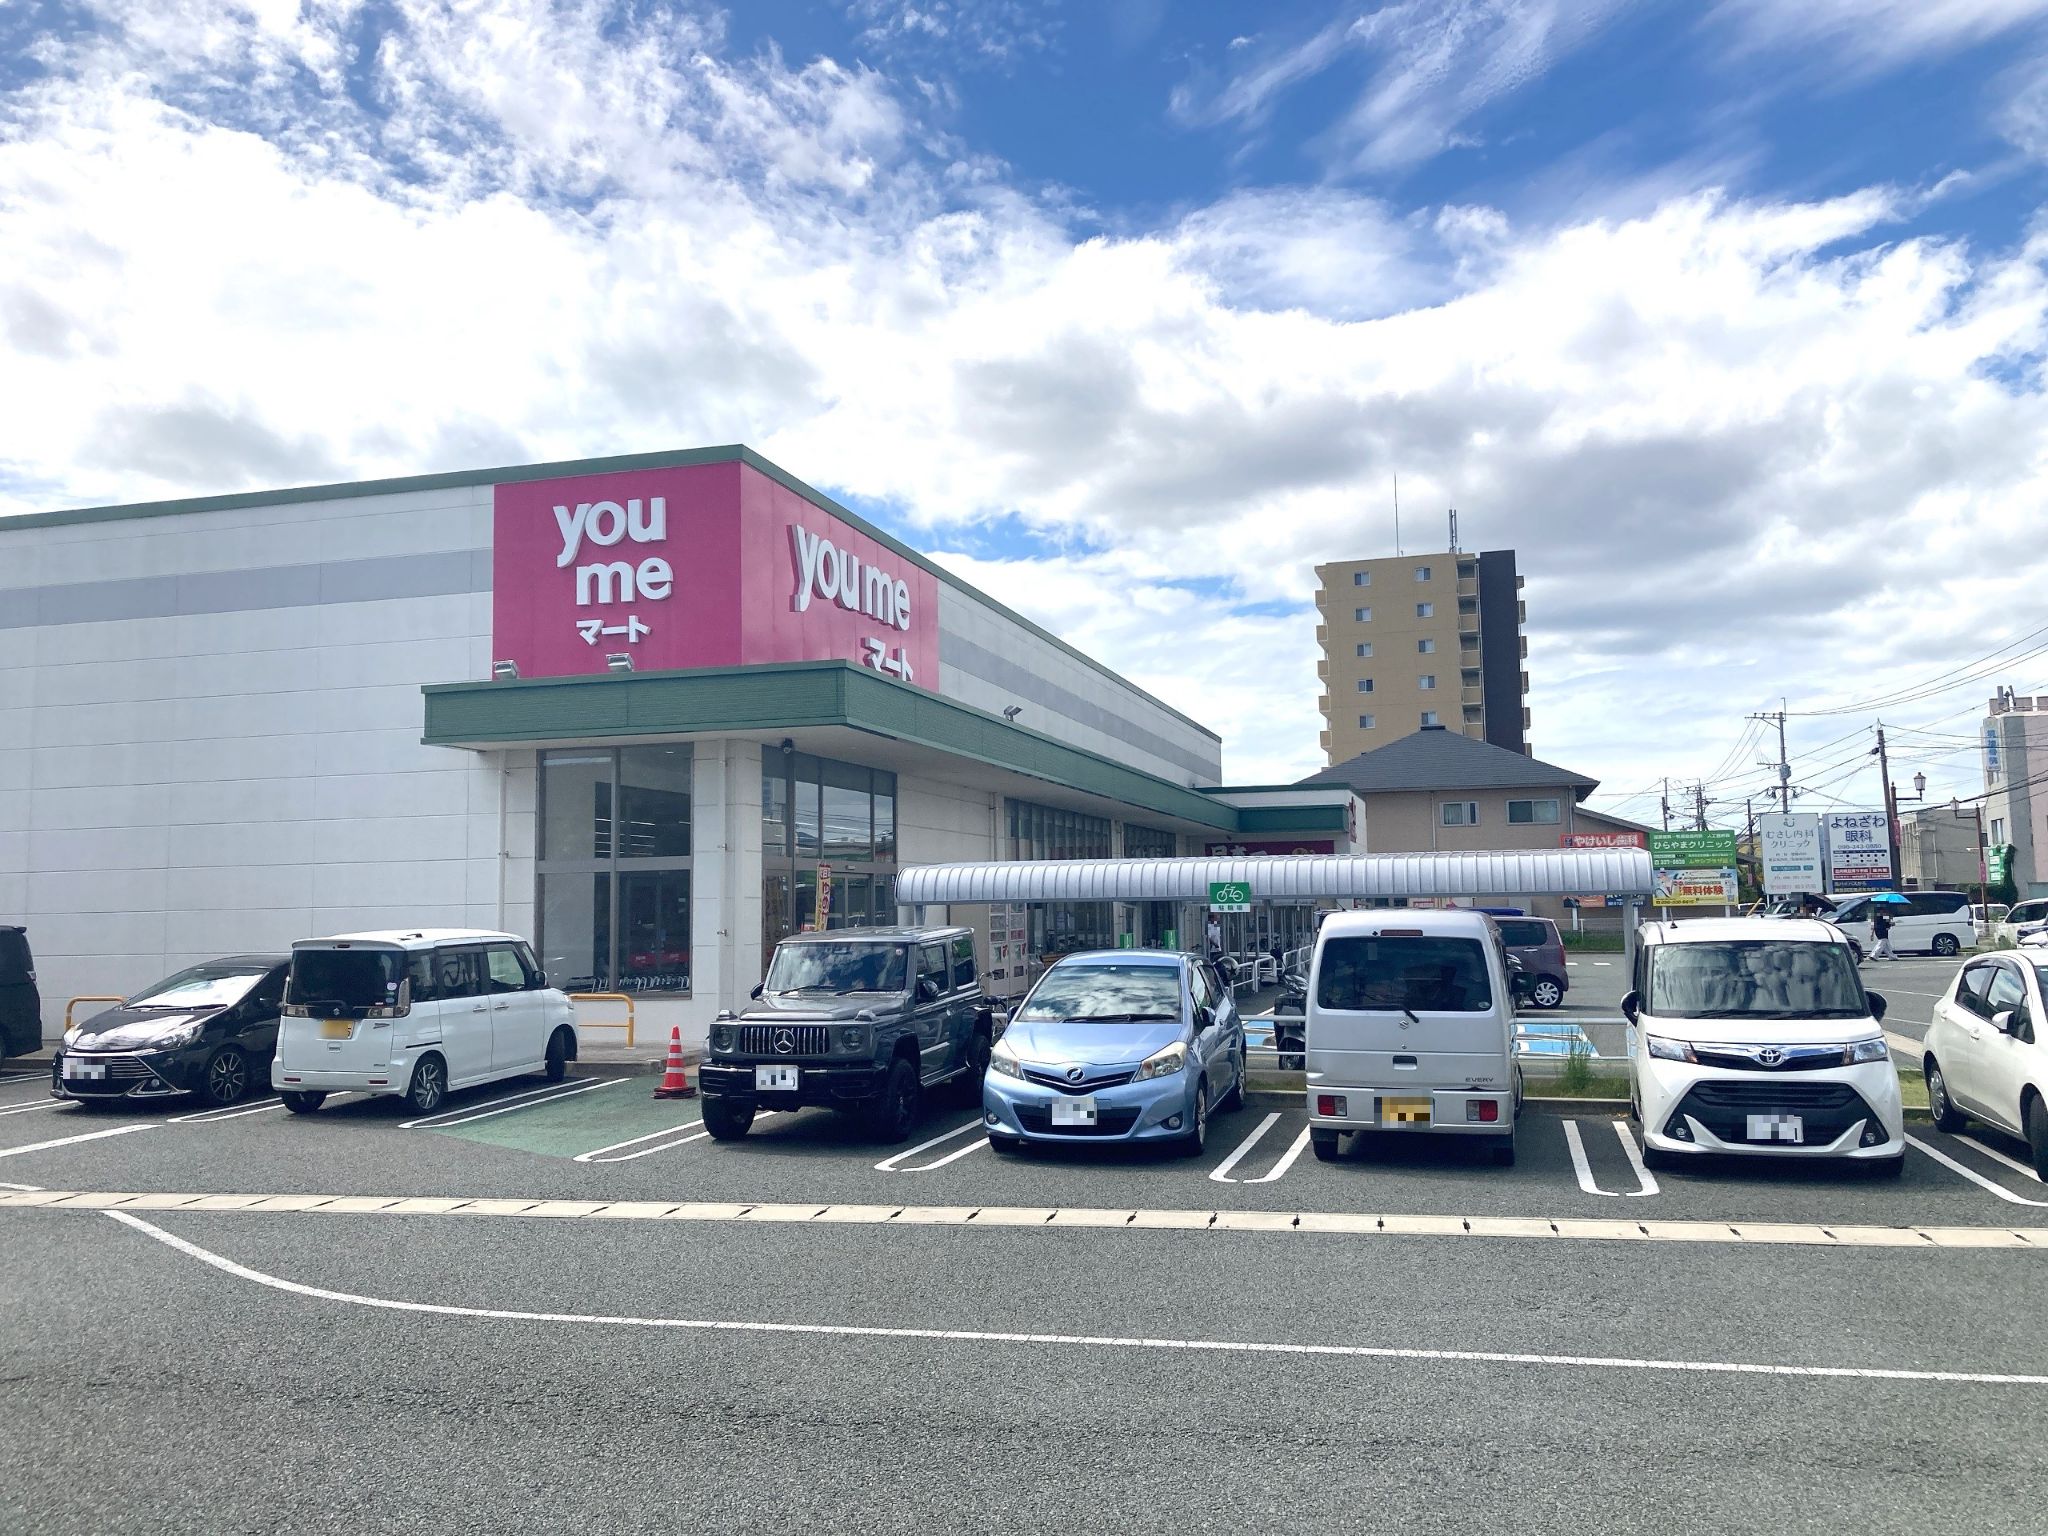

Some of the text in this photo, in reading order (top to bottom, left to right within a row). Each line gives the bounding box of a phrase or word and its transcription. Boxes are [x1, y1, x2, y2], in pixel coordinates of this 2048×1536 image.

[553, 497, 666, 568] you
[576, 557, 674, 606] me
[576, 614, 651, 646] マート
[863, 636, 914, 682] マート
[1831, 814, 1886, 829] よねざわ
[1574, 834, 1638, 847] やけいし歯科
[1766, 829, 1814, 839] むさし内科
[1845, 829, 1873, 842] 眼科
[1653, 840, 1732, 849] ひらやまクリニック
[1770, 840, 1810, 849] クリニック
[1682, 885, 1724, 896] 無料体験
